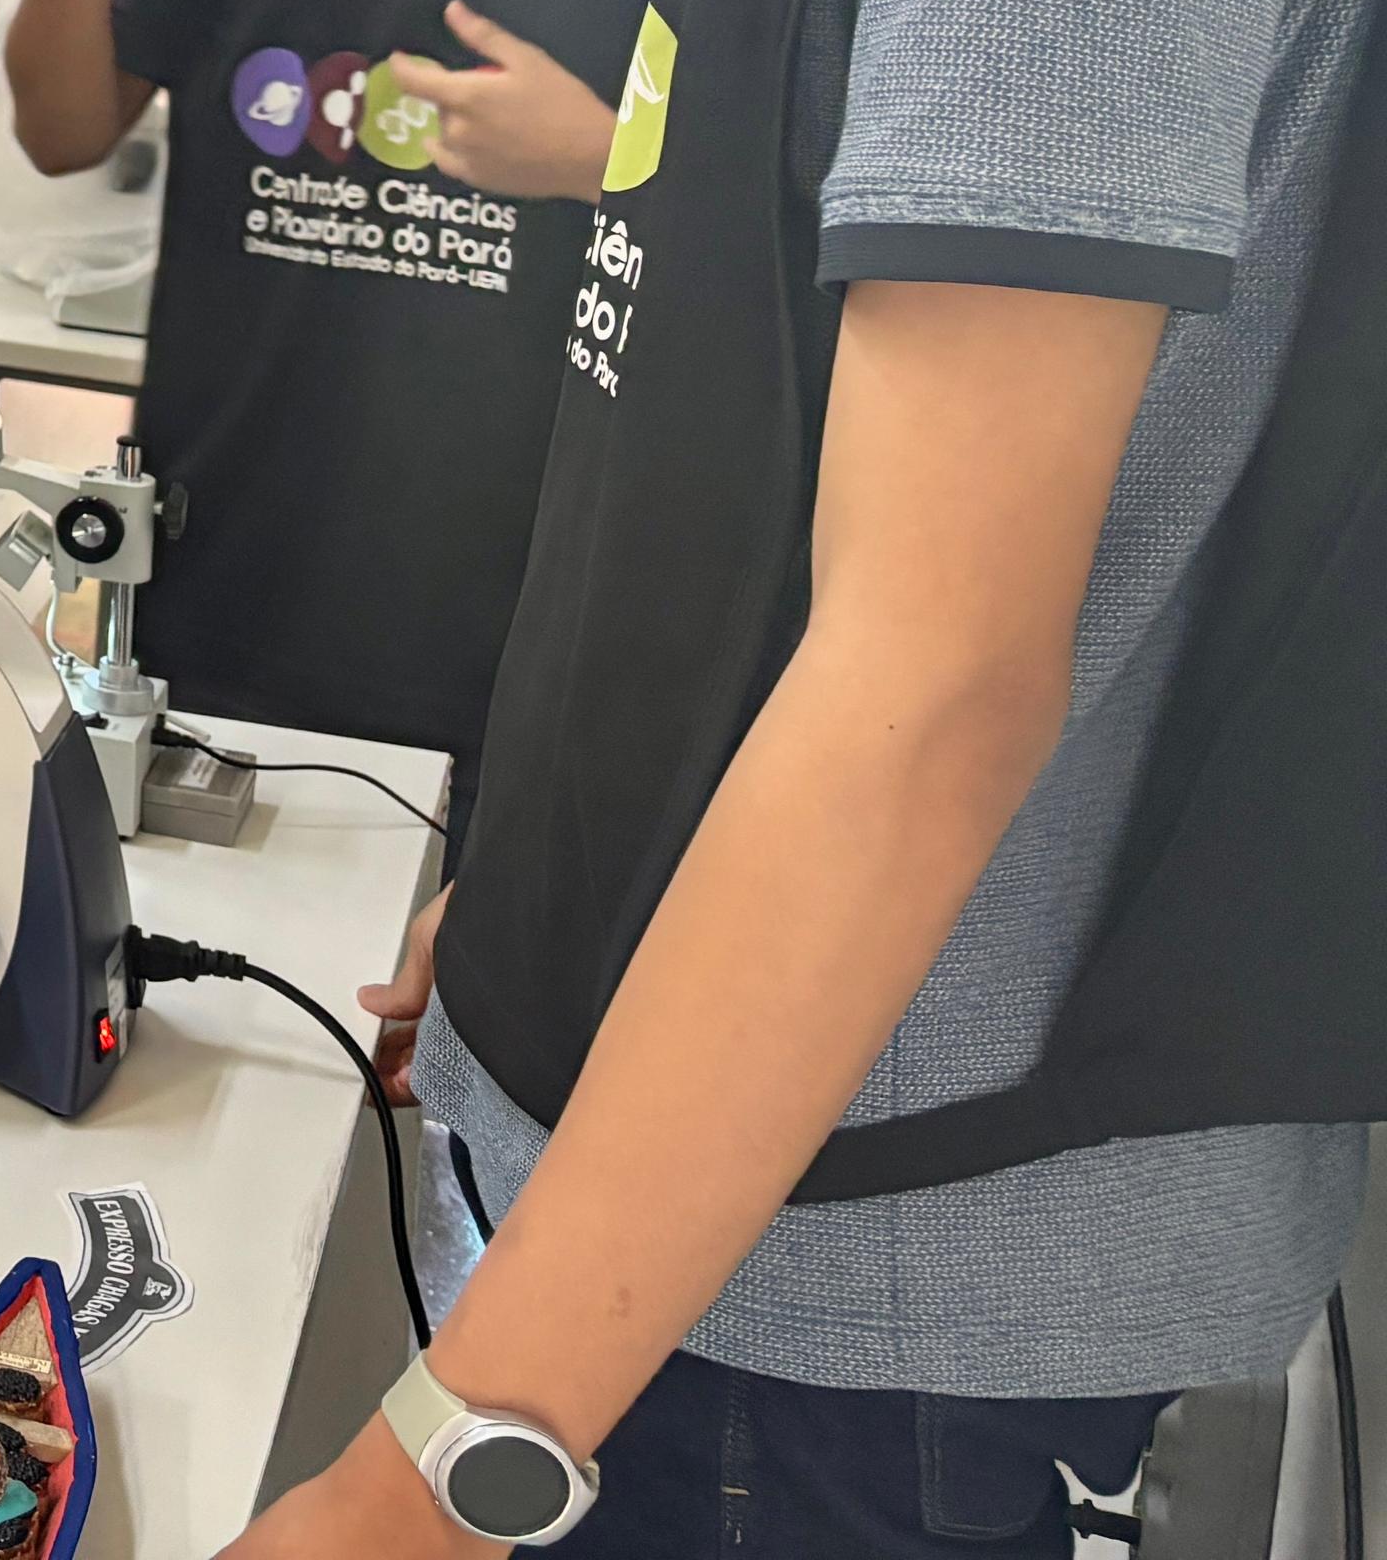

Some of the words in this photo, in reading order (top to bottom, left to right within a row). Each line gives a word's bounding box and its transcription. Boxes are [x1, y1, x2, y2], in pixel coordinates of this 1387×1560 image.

[377, 178, 518, 233] Ciências
[245, 208, 269, 233] e
[392, 222, 430, 257] do
[438, 227, 512, 271] Pará
[575, 281, 617, 341] do
[93, 1199, 135, 1275] EXPRESSO
[72, 1276, 130, 1326] CHAGAS
